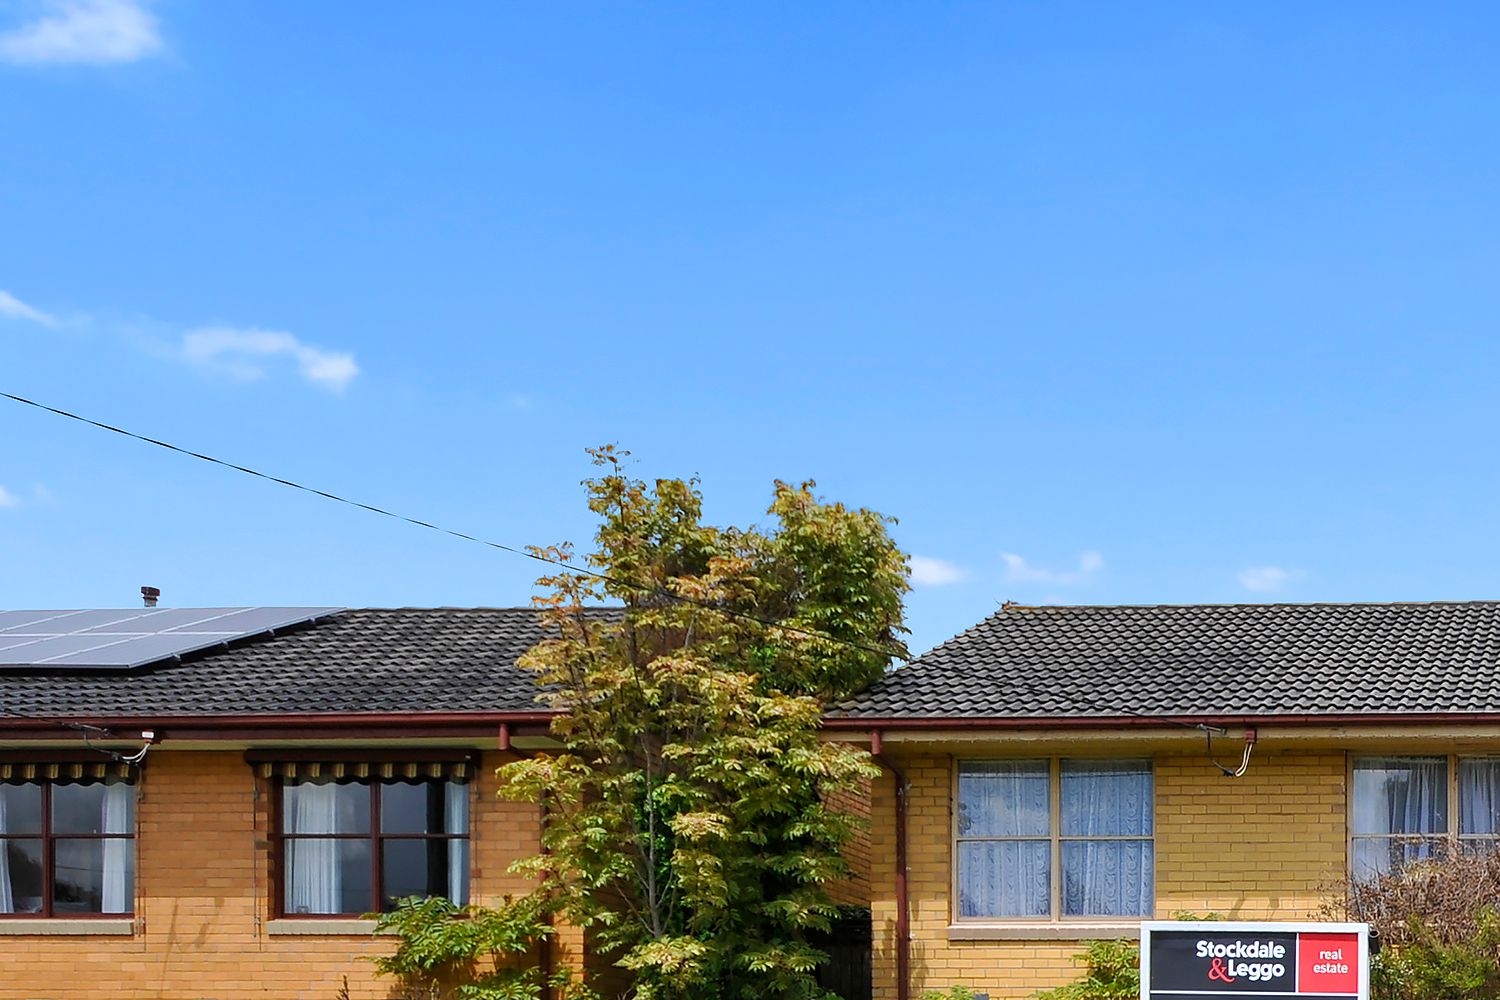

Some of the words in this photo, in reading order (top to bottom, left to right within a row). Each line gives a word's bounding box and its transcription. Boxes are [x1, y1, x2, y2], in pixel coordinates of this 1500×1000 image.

[1196, 940, 1286, 959] Stockdale
[1319, 948, 1343, 960] real
[1313, 963, 1349, 974] estate
